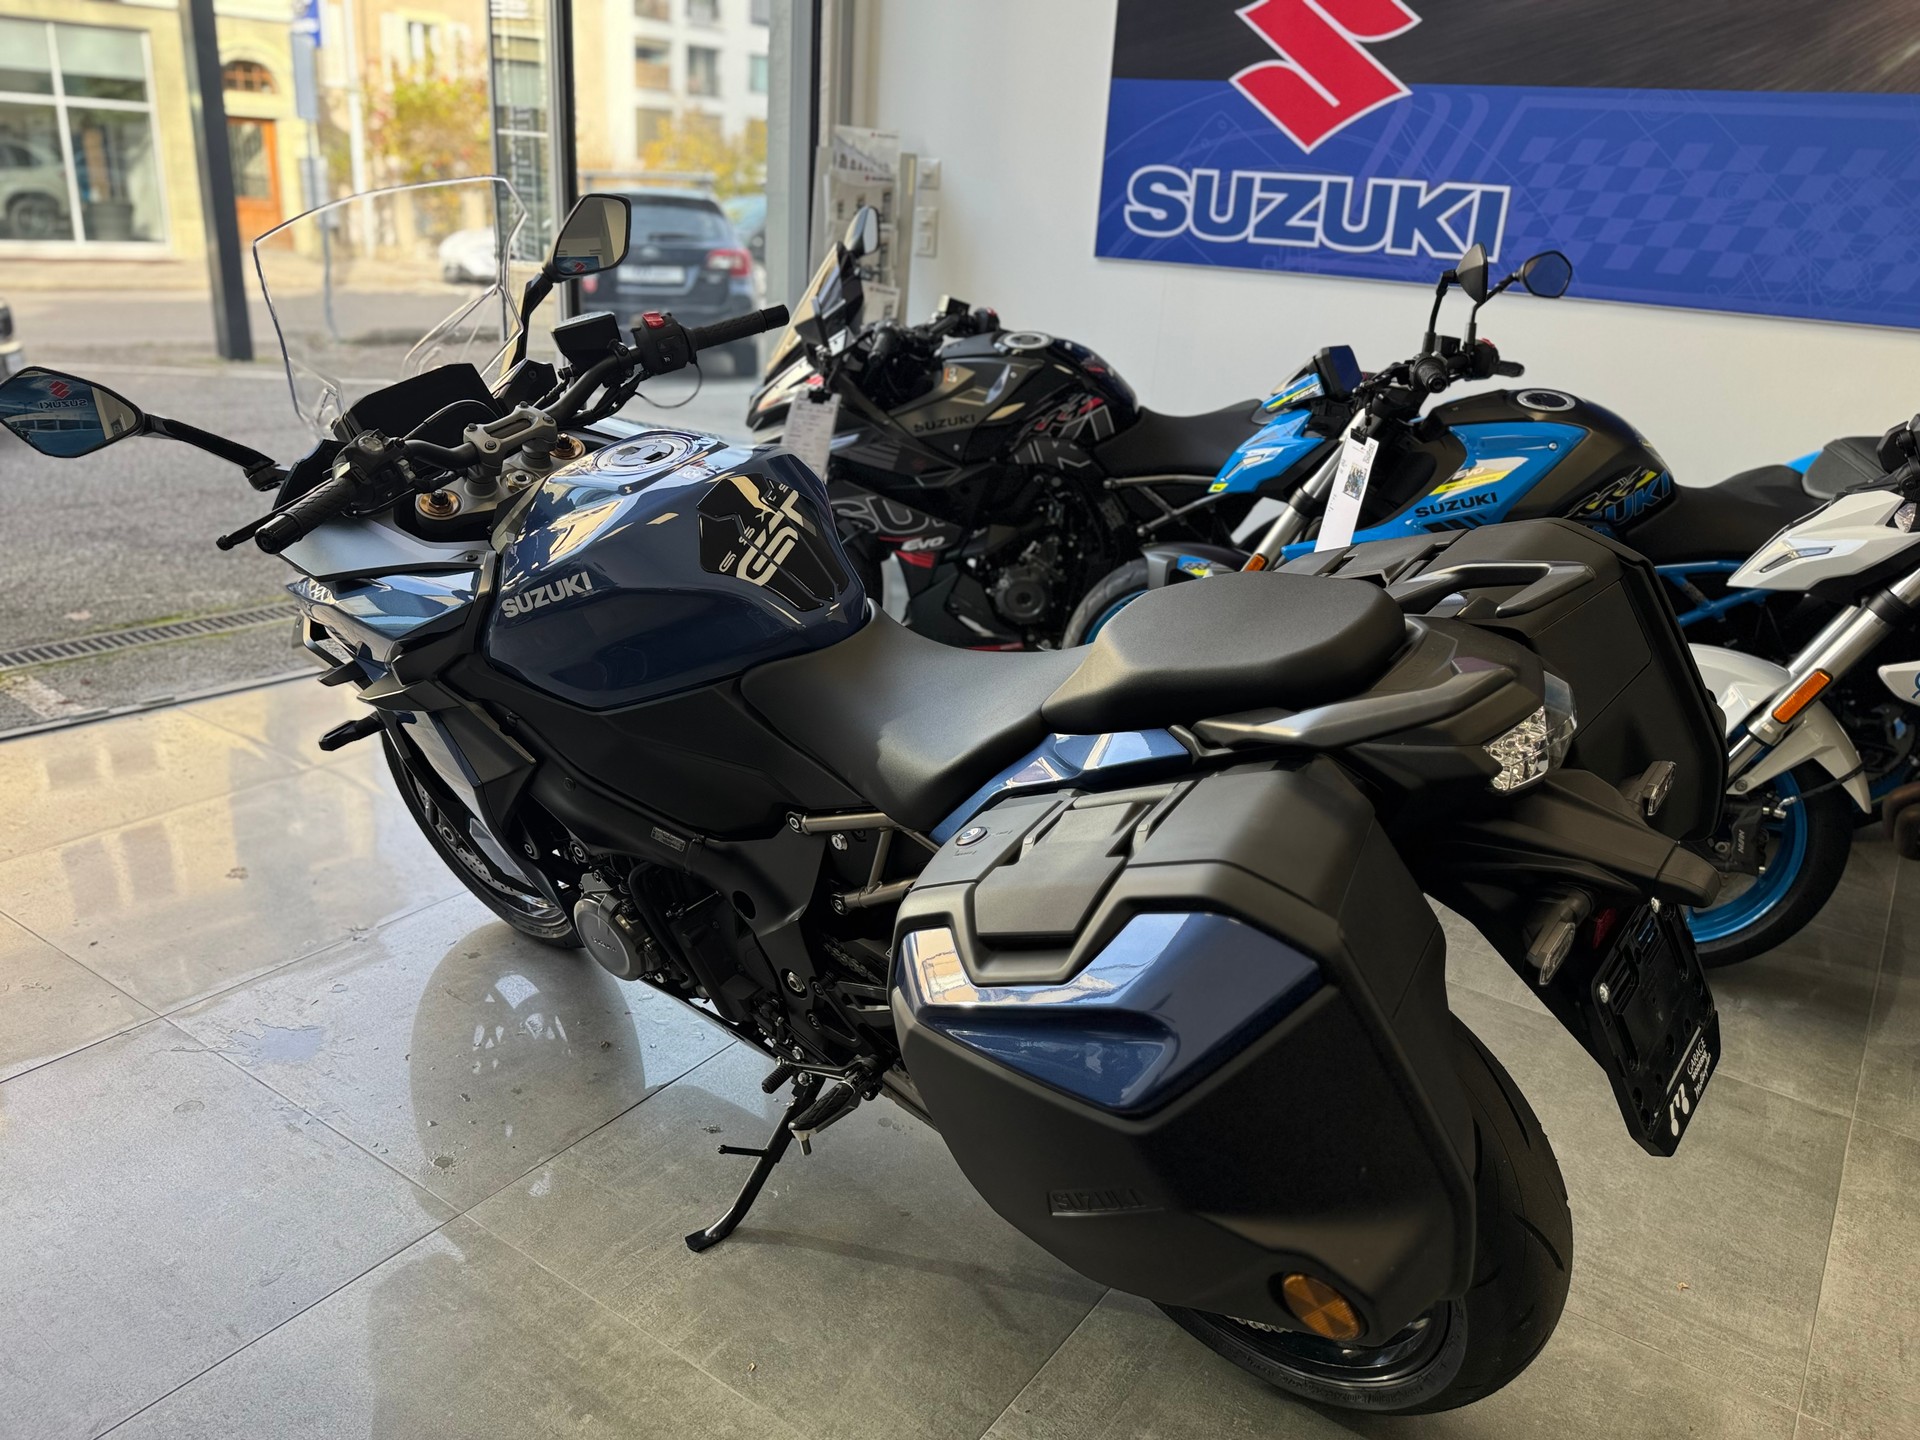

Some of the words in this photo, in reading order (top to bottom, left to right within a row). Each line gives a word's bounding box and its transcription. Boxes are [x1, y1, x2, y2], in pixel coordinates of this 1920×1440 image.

[1124, 164, 1511, 263] SUZUKI
[914, 414, 976, 433] SUZUKI
[1415, 492, 1498, 518] SUZUKI
[501, 571, 593, 618] SUZUKI
